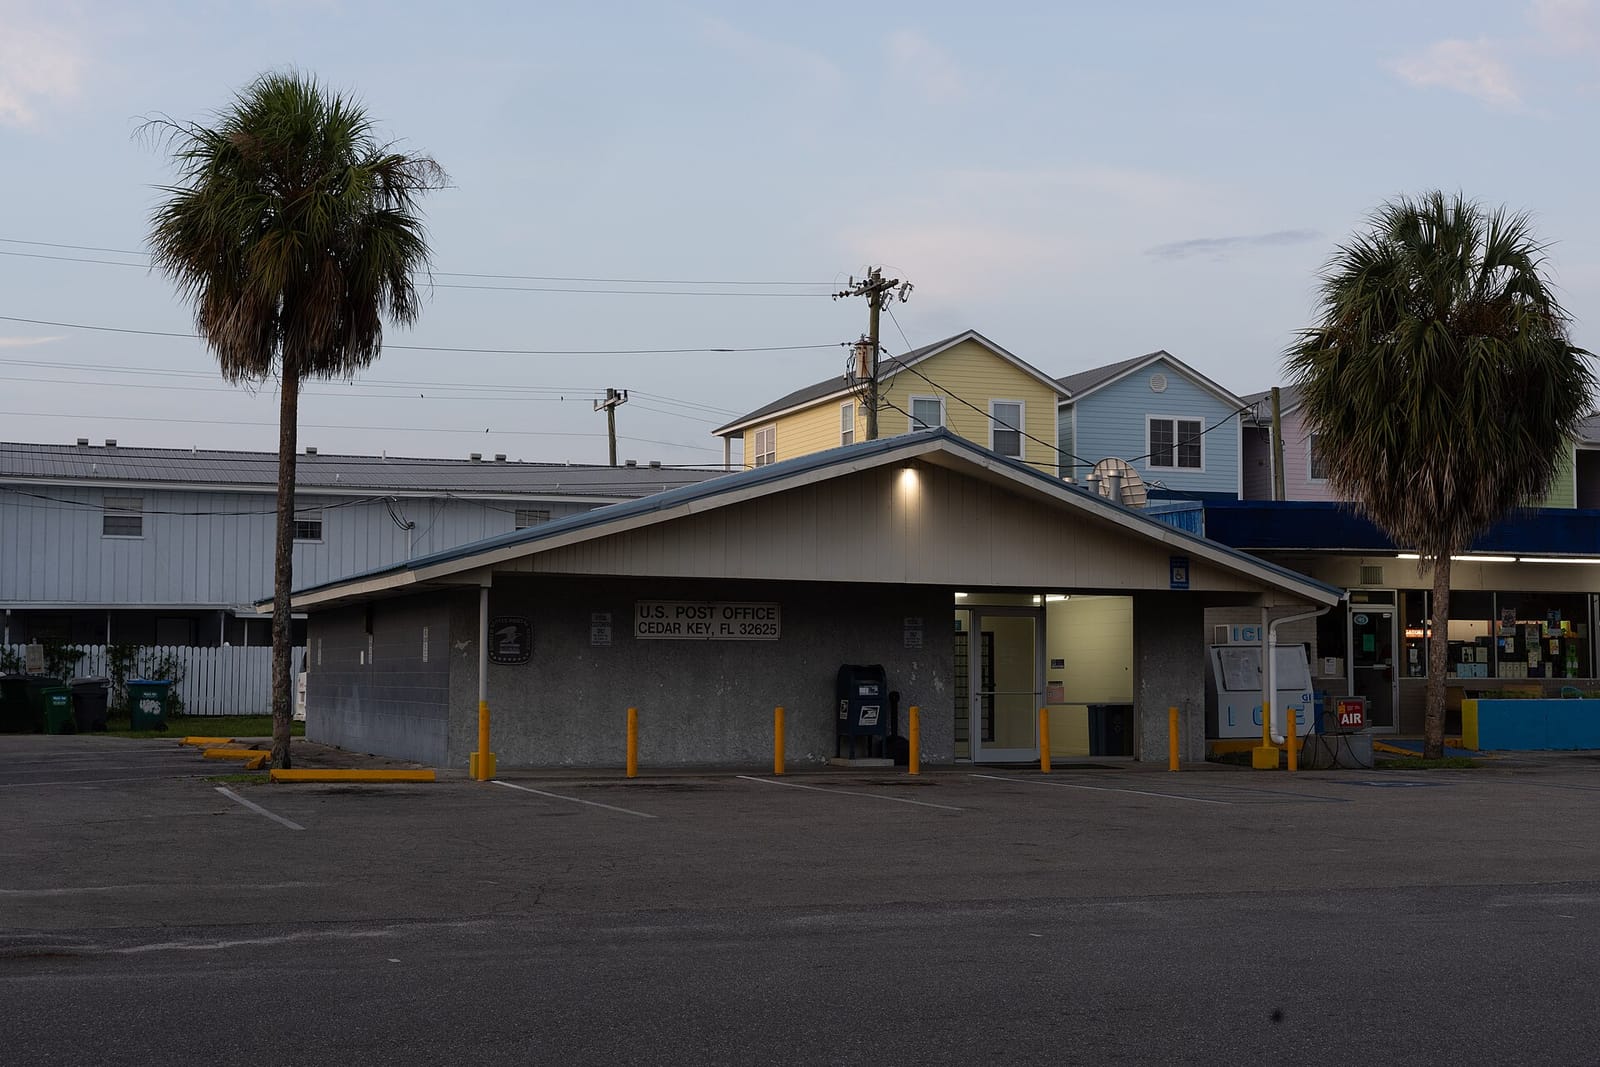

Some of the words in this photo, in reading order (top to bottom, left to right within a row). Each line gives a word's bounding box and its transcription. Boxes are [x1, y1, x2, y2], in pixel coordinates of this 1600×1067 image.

[639, 605, 669, 619] U.S.
[675, 606, 716, 620] POST
[722, 607, 776, 620] OFFICE
[638, 622, 681, 634] CEDAR
[687, 622, 715, 636] KEY,
[720, 624, 734, 635] FL
[739, 623, 777, 636] 32625
[1233, 625, 1263, 641] IC
[1341, 713, 1362, 725] AIR
